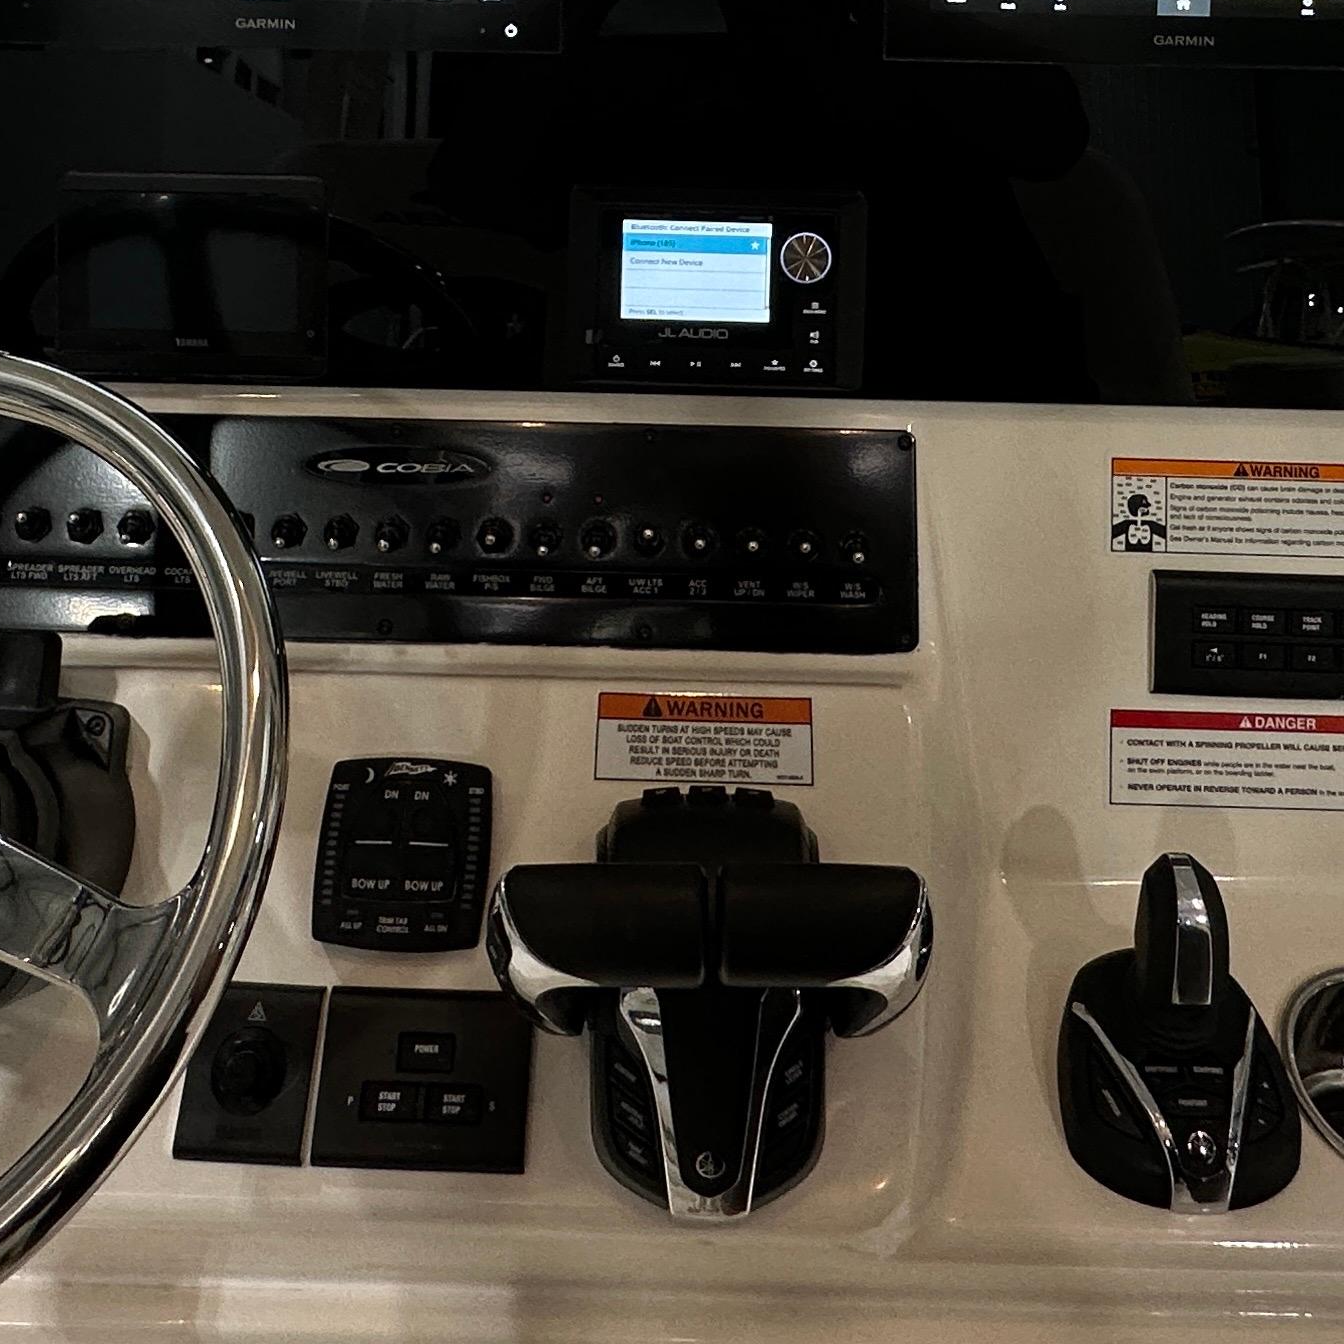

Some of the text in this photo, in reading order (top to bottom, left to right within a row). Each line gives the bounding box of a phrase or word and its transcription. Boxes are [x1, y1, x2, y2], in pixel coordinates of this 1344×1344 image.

[235, 18, 296, 30] GARMIN
[1153, 34, 1215, 47] GARMIN
[726, 226, 750, 234] Device
[679, 258, 703, 267] Device
[658, 327, 729, 340] JL AUDIO
[376, 462, 475, 474] COBIA
[1251, 466, 1320, 479] WARNING
[109, 566, 157, 575] OVERHEAD
[667, 700, 764, 718] WARNING
[1255, 717, 1317, 730] DANGER
[617, 724, 792, 737] SUDDEN TURNS AT HIGH SPEEDS MAY CAUSE
[626, 735, 781, 747] LOSS OF BOAT CONTROL WHICH COULD
[628, 745, 780, 758] RESULT IN SERIOUS INJURY OR DEATH
[630, 756, 778, 768] REDUCE SPEED BEFORE ATTEMPTING
[1126, 757, 1202, 767] SHUT OFF ENGINES
[655, 768, 751, 779] A SUDDEN SHARP TURN.
[384, 790, 430, 801] DN DN
[351, 878, 391, 890] BOW UP
[404, 880, 444, 892] BOW UP
